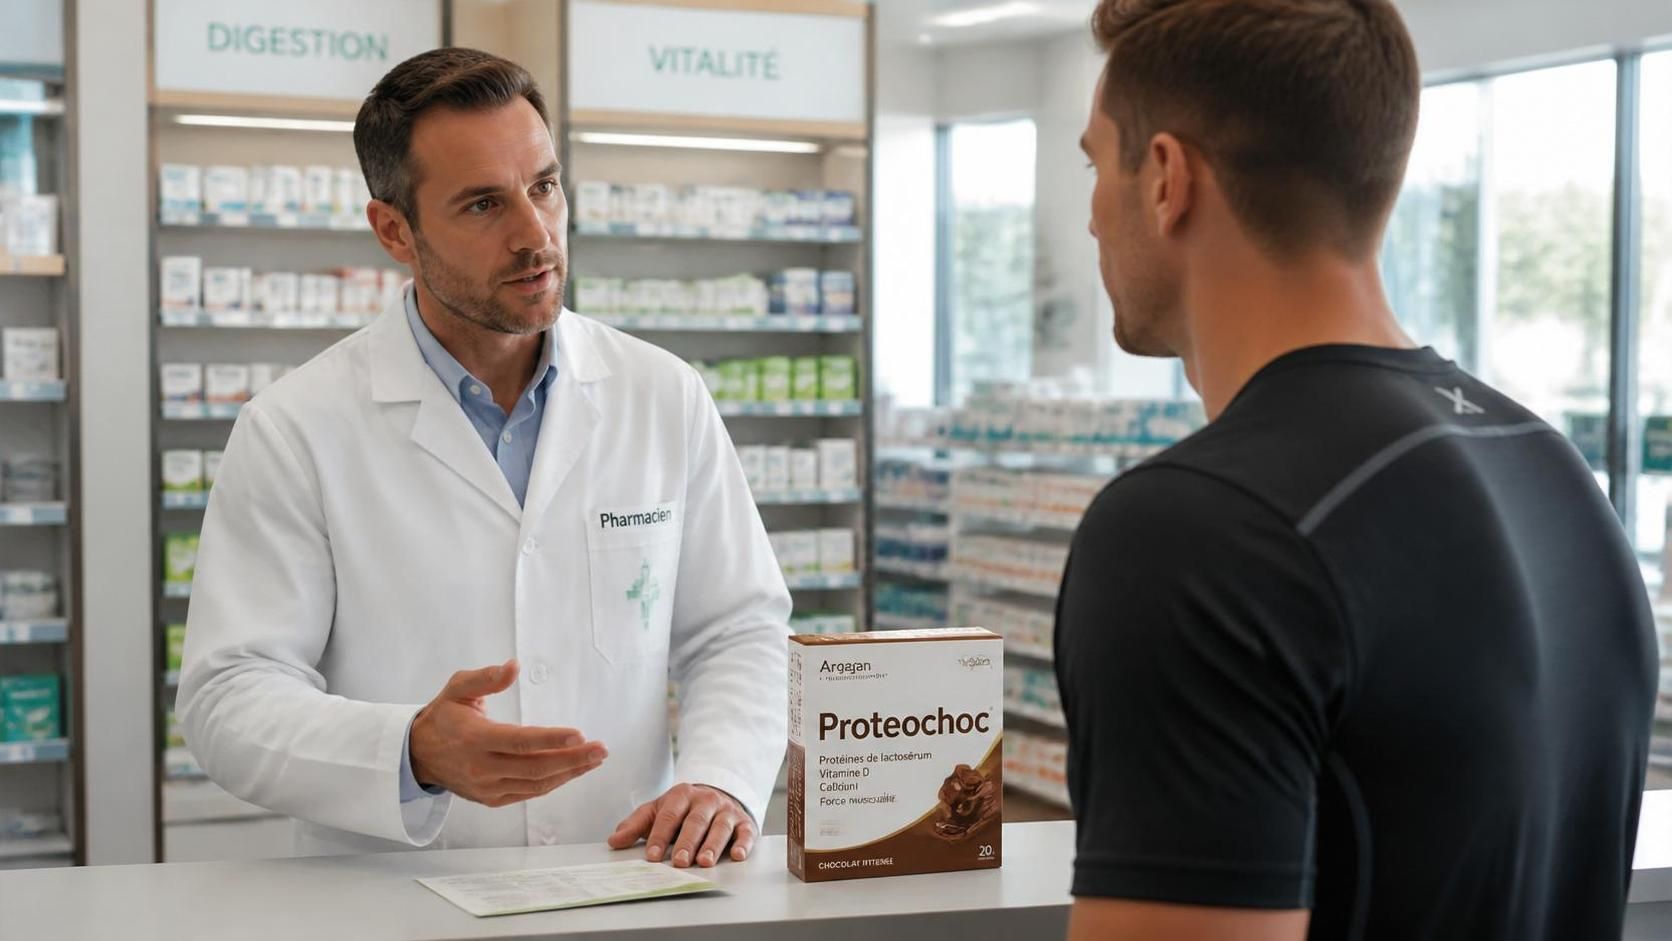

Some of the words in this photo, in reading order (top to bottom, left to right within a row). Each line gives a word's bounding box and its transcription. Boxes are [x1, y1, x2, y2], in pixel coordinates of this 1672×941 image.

[207, 22, 390, 60] DIGESTION
[600, 508, 672, 528] Pharmacien
[819, 707, 990, 740] Proteochoc
[819, 754, 864, 765] Protéines
[866, 753, 879, 763] de
[880, 751, 933, 762] lactosérum
[819, 768, 860, 779] Vitamine
[862, 767, 870, 777] D
[820, 796, 847, 807] Force
